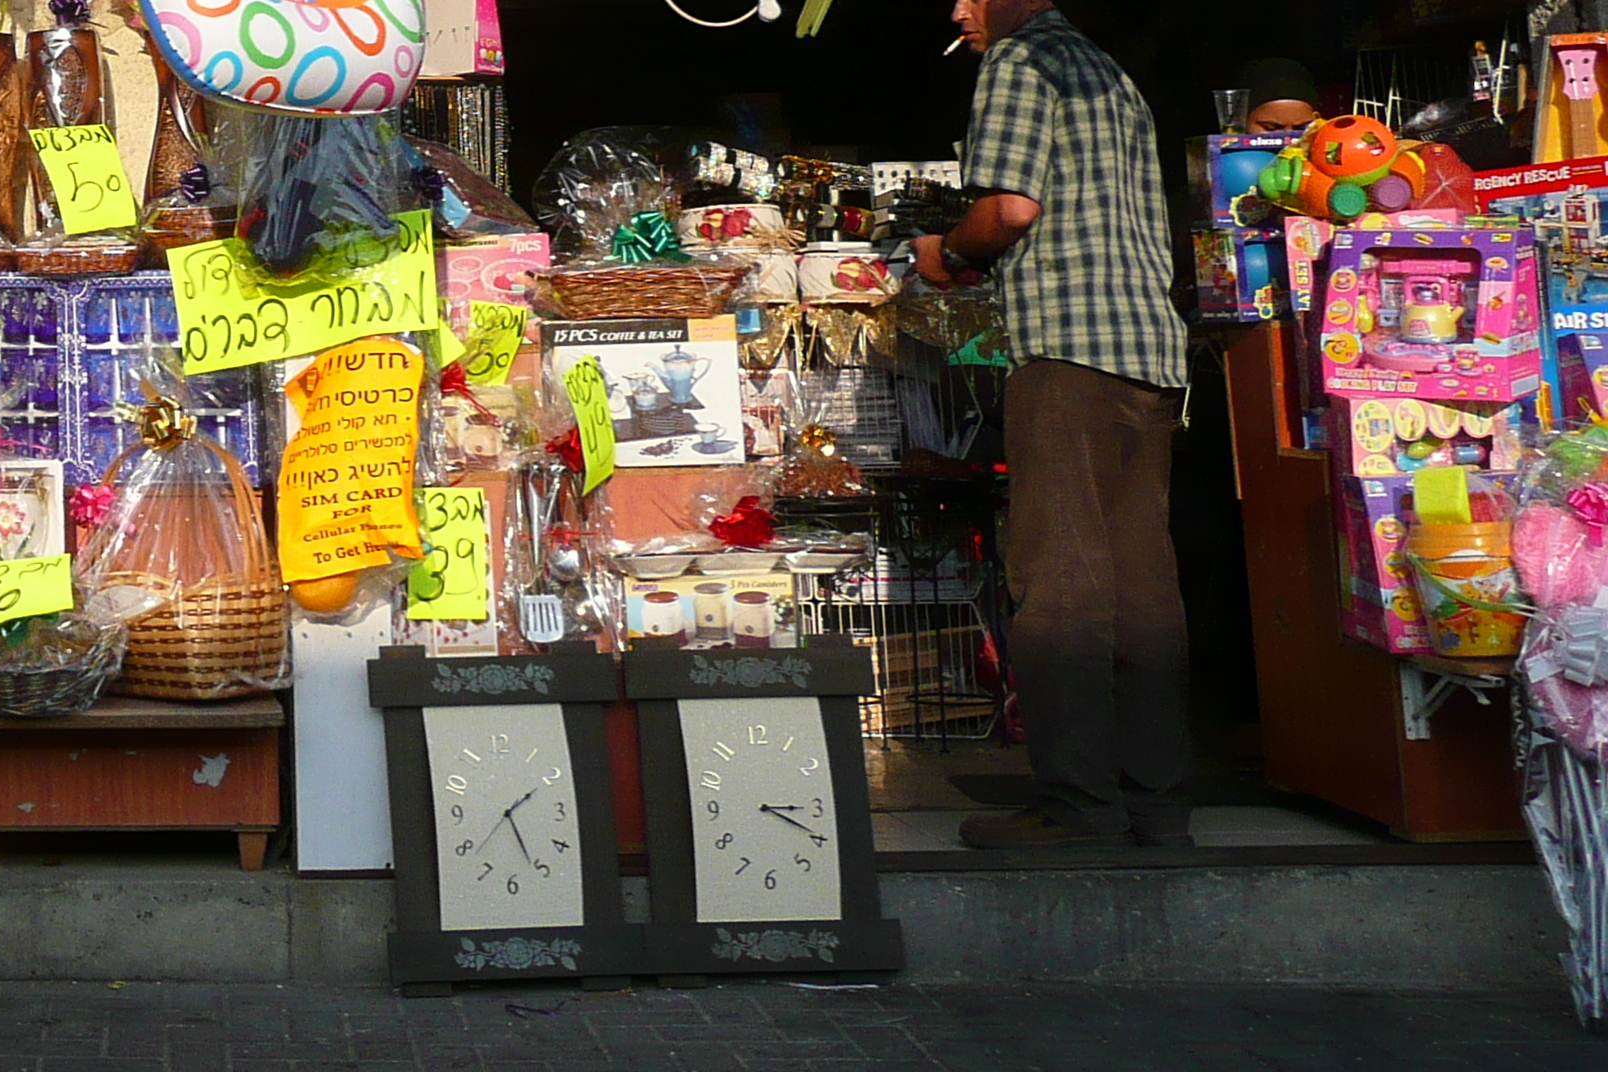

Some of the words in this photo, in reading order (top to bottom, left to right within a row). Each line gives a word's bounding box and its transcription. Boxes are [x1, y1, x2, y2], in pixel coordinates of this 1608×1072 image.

[1524, 166, 1571, 184] RESCUE
[67, 161, 121, 213] 50
[508, 238, 542, 255] 7pcs
[1297, 288, 1311, 311] LAY
[1554, 312, 1587, 329] AIR
[568, 329, 598, 342] PCS
[599, 331, 636, 342] COFFEE
[647, 330, 665, 340] TEA
[665, 329, 684, 340] SET
[334, 387, 414, 407] כרטיסי
[337, 416, 366, 431] קולי
[373, 413, 397, 427] תא
[348, 456, 411, 480] להשיג
[301, 493, 339, 508] SIM
[346, 486, 403, 502] CARD
[332, 504, 372, 520] FOR
[303, 526, 357, 543] Cellular
[313, 552, 332, 565] To
[335, 545, 361, 560] Get
[416, 537, 480, 603] 39
[491, 733, 510, 754] 12
[748, 724, 768, 744] 12
[783, 736, 795, 751] 1
[525, 748, 538, 763] 1
[712, 741, 735, 761] 11
[799, 757, 819, 776] 2
[445, 774, 468, 796] 10
[542, 767, 561, 786] 2
[700, 770, 722, 791] 10
[451, 804, 464, 825] 9
[554, 802, 566, 822] 3
[707, 800, 719, 821] 9
[811, 797, 824, 818] 3
[455, 839, 474, 856] 8
[551, 839, 570, 854] 4
[715, 832, 733, 850] 8
[808, 833, 829, 848] 4
[477, 862, 494, 881] 7
[533, 858, 551, 878] 5
[735, 857, 751, 875] 7
[794, 853, 812, 872] 5
[507, 874, 519, 895] 6
[764, 869, 776, 890] 6
